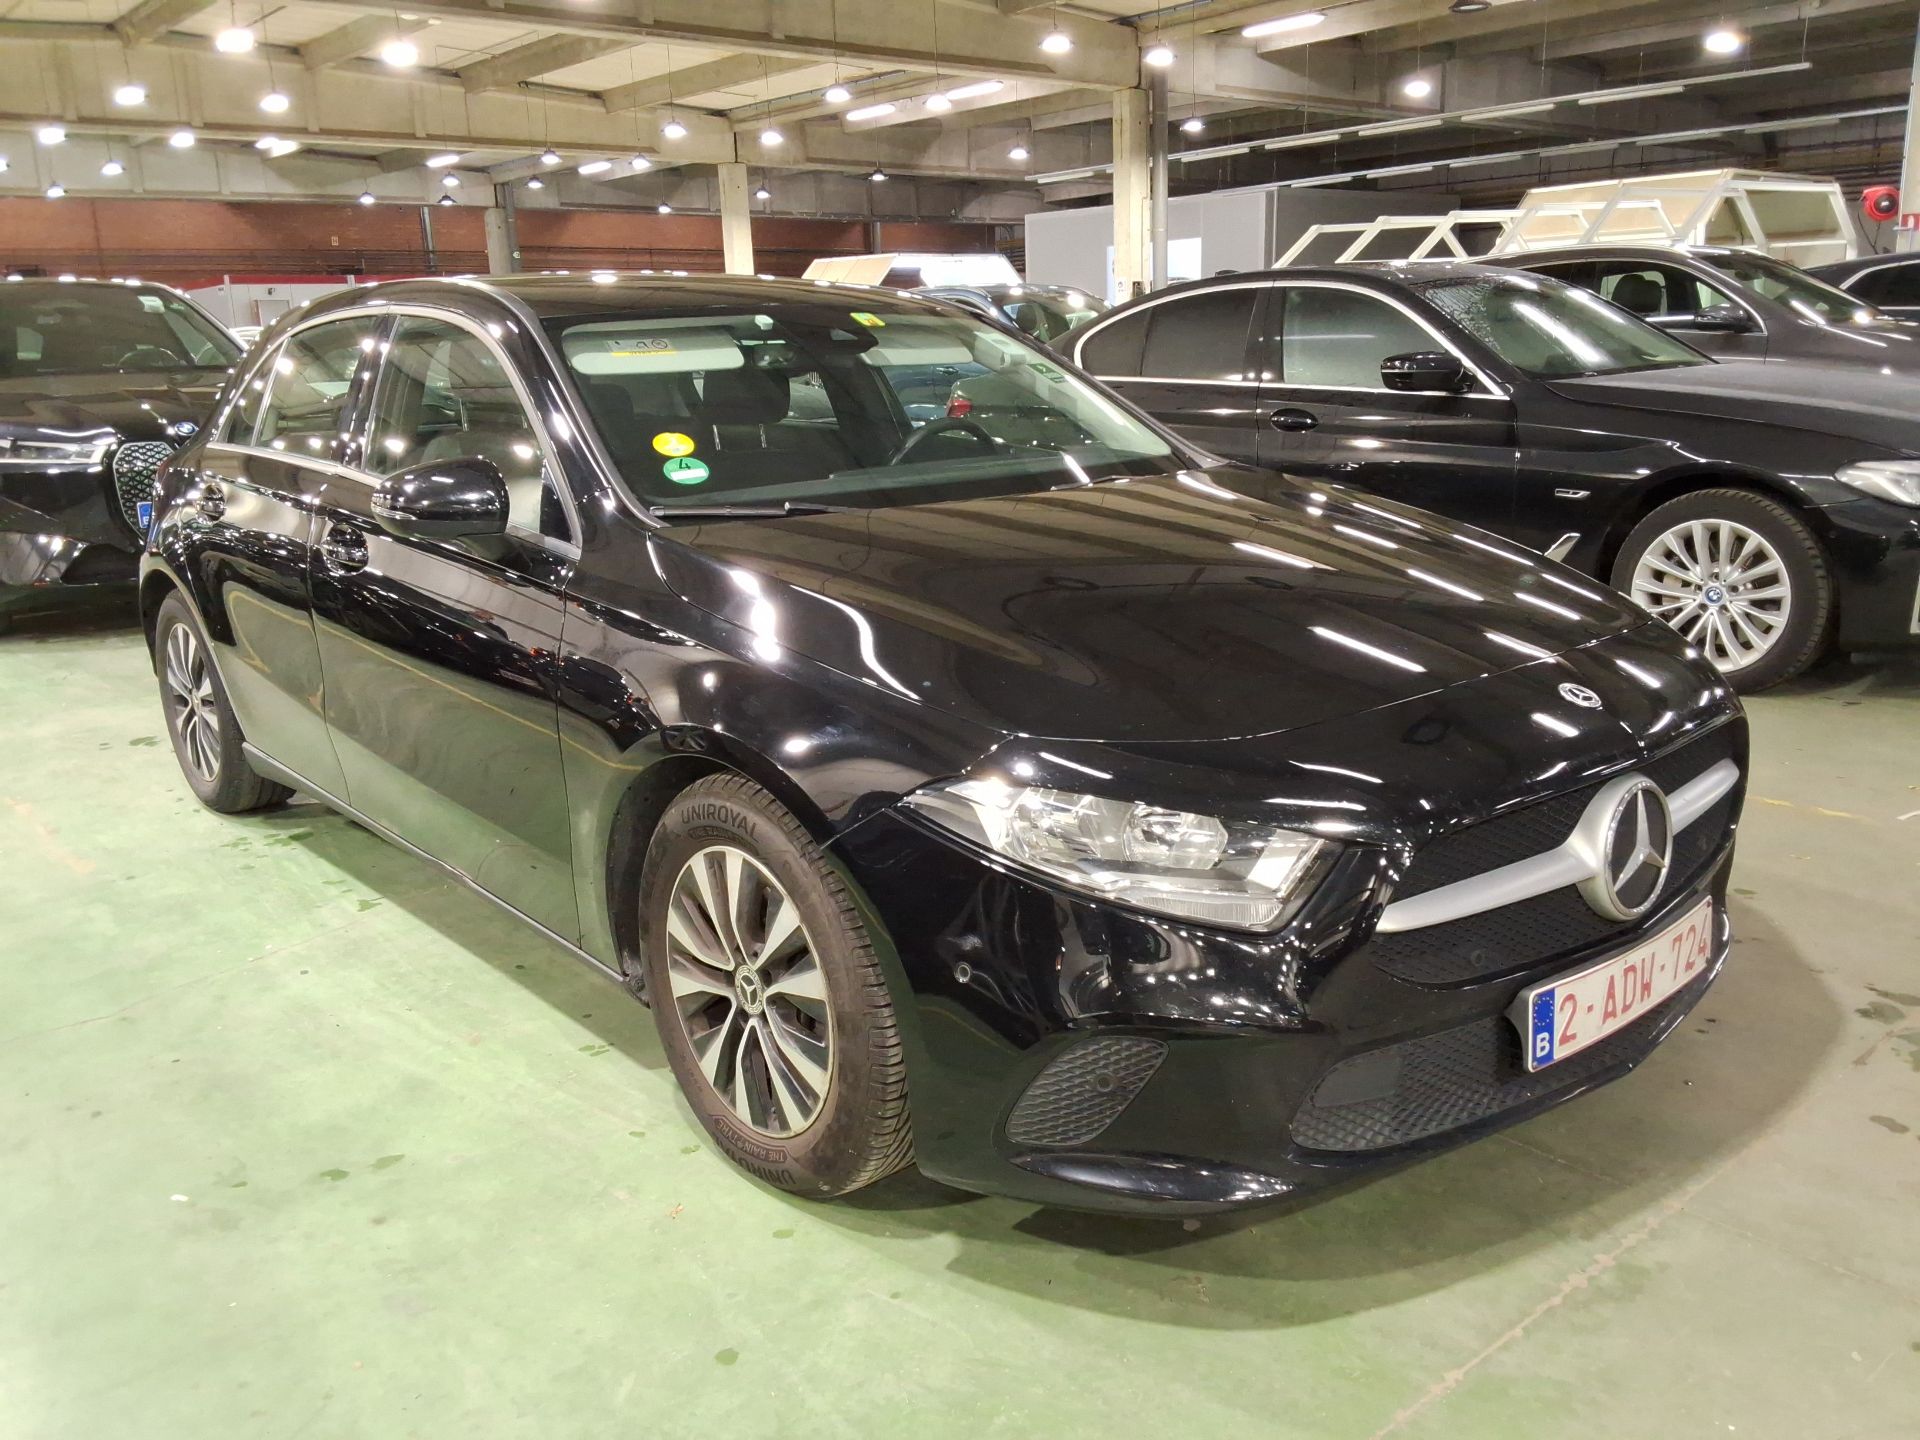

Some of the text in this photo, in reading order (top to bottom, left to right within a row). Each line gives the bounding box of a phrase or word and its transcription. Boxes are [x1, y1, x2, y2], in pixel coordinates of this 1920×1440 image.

[678, 458, 692, 471] 4
[681, 803, 760, 844] UNIROYAL
[1535, 912, 1709, 1059] B 2-ADW-724
[714, 1132, 797, 1185] UNIRO
[716, 1118, 785, 1163] THE RAIN TYRE
